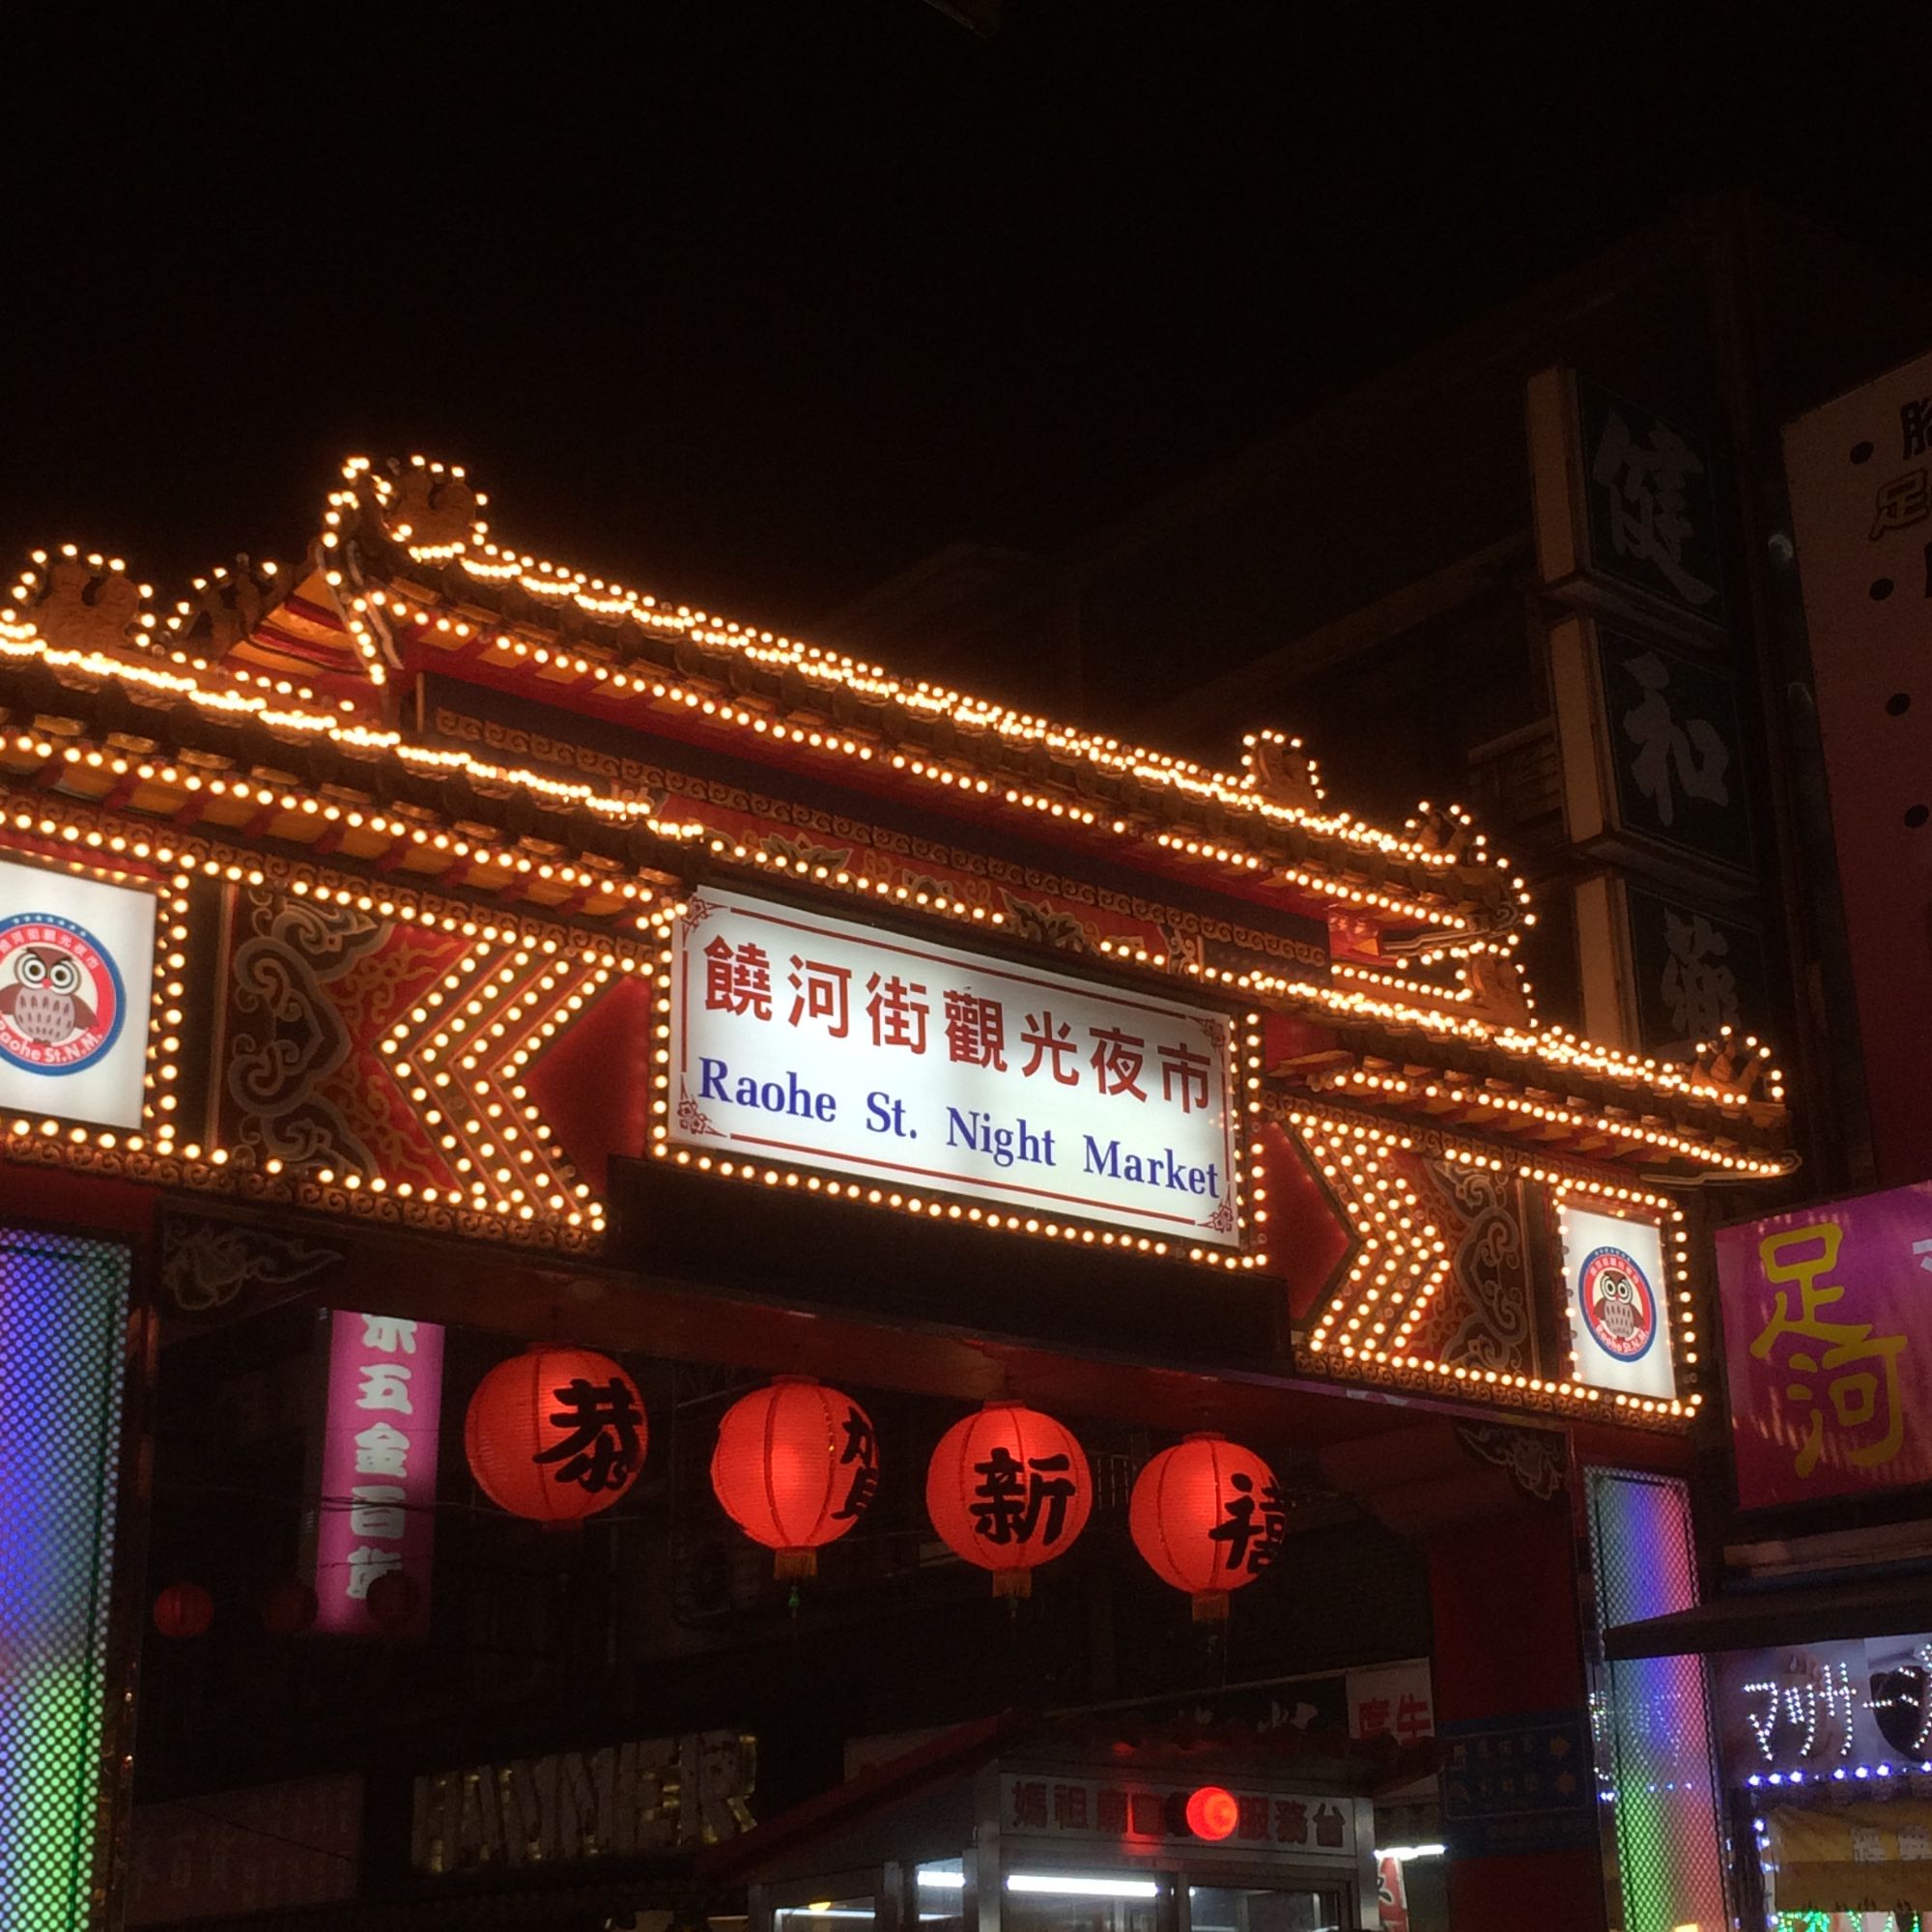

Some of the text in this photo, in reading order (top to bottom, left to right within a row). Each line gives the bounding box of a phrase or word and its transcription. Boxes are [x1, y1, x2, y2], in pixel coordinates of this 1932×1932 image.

[704, 934, 1211, 1115] 饒河街觀光夜市
[698, 1057, 1220, 1200] Raohe St. Night Market
[1749, 1221, 1908, 1479] 足河
[533, 1377, 643, 1493] 恭
[969, 1447, 1076, 1546] 新
